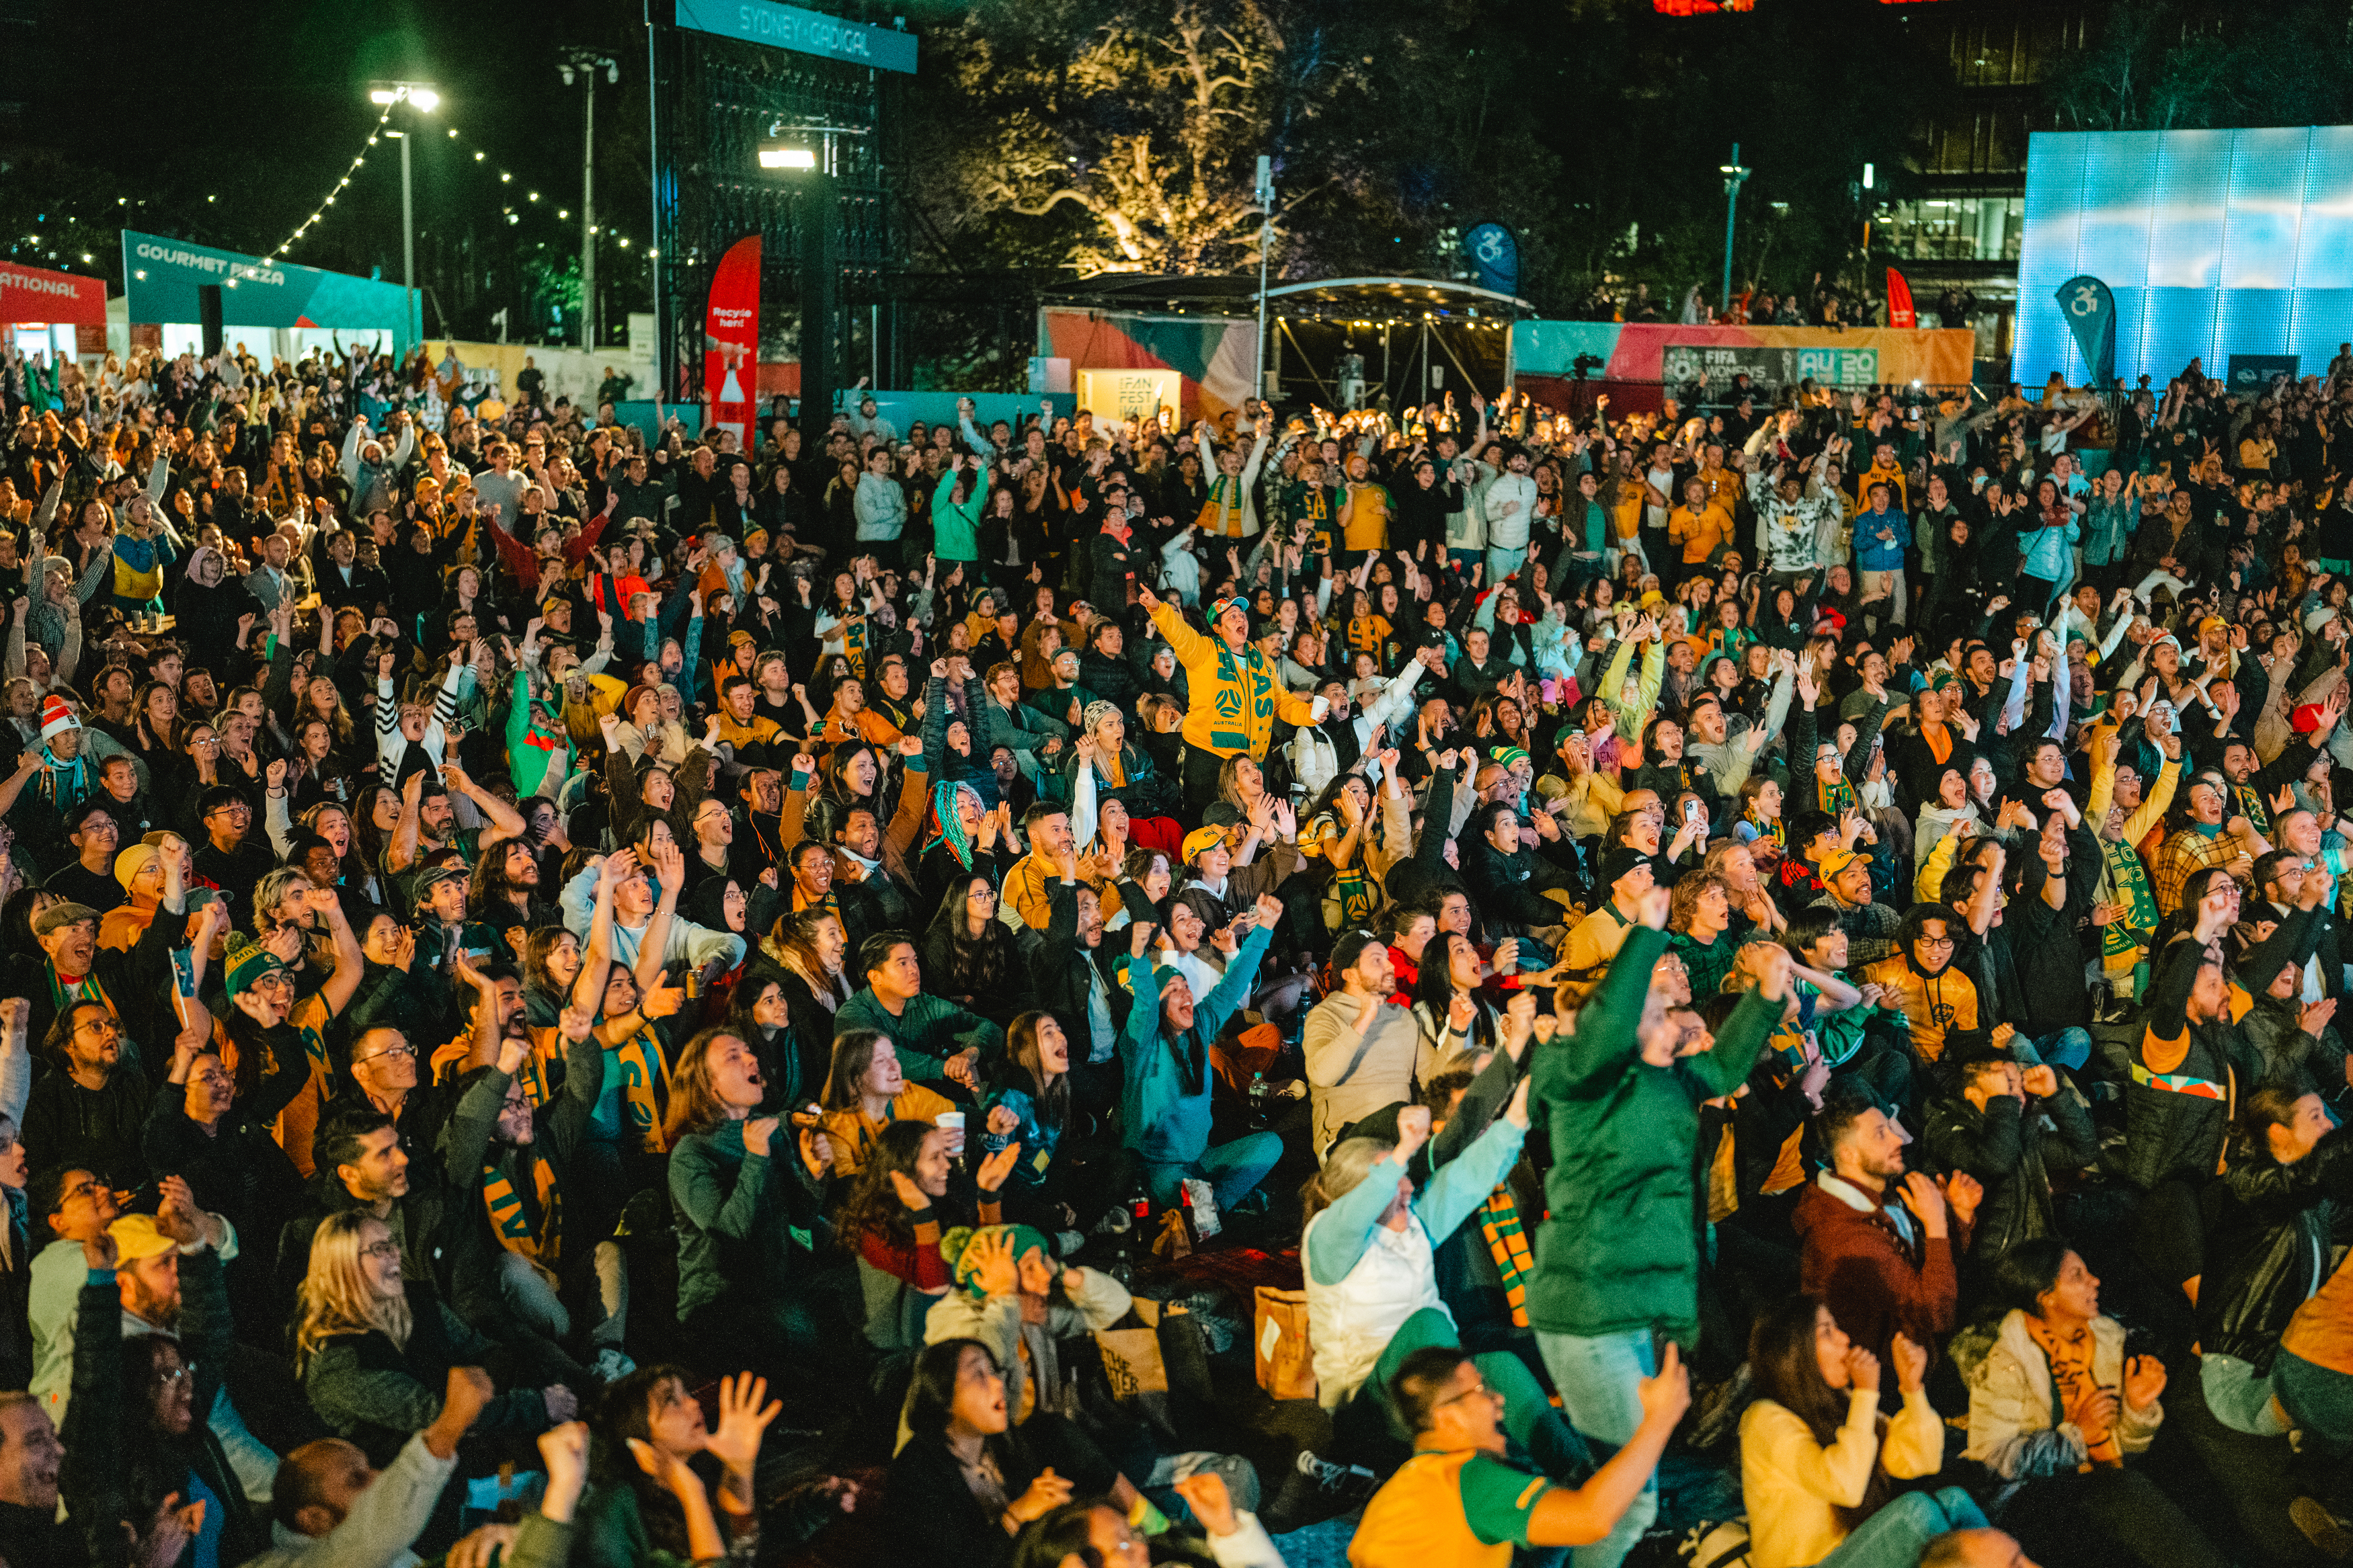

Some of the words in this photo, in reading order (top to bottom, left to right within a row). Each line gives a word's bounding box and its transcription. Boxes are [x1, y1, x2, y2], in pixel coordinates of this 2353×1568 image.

[740, 5, 802, 42] SYDNEY
[136, 243, 228, 275] GOURMET
[713, 306, 752, 319] Recycle
[1705, 350, 1737, 365] FIFA
[1800, 352, 1834, 372] AU
[1841, 354, 1874, 372] 20
[1125, 377, 1152, 389] FAN
[1120, 391, 1152, 403] FEST
